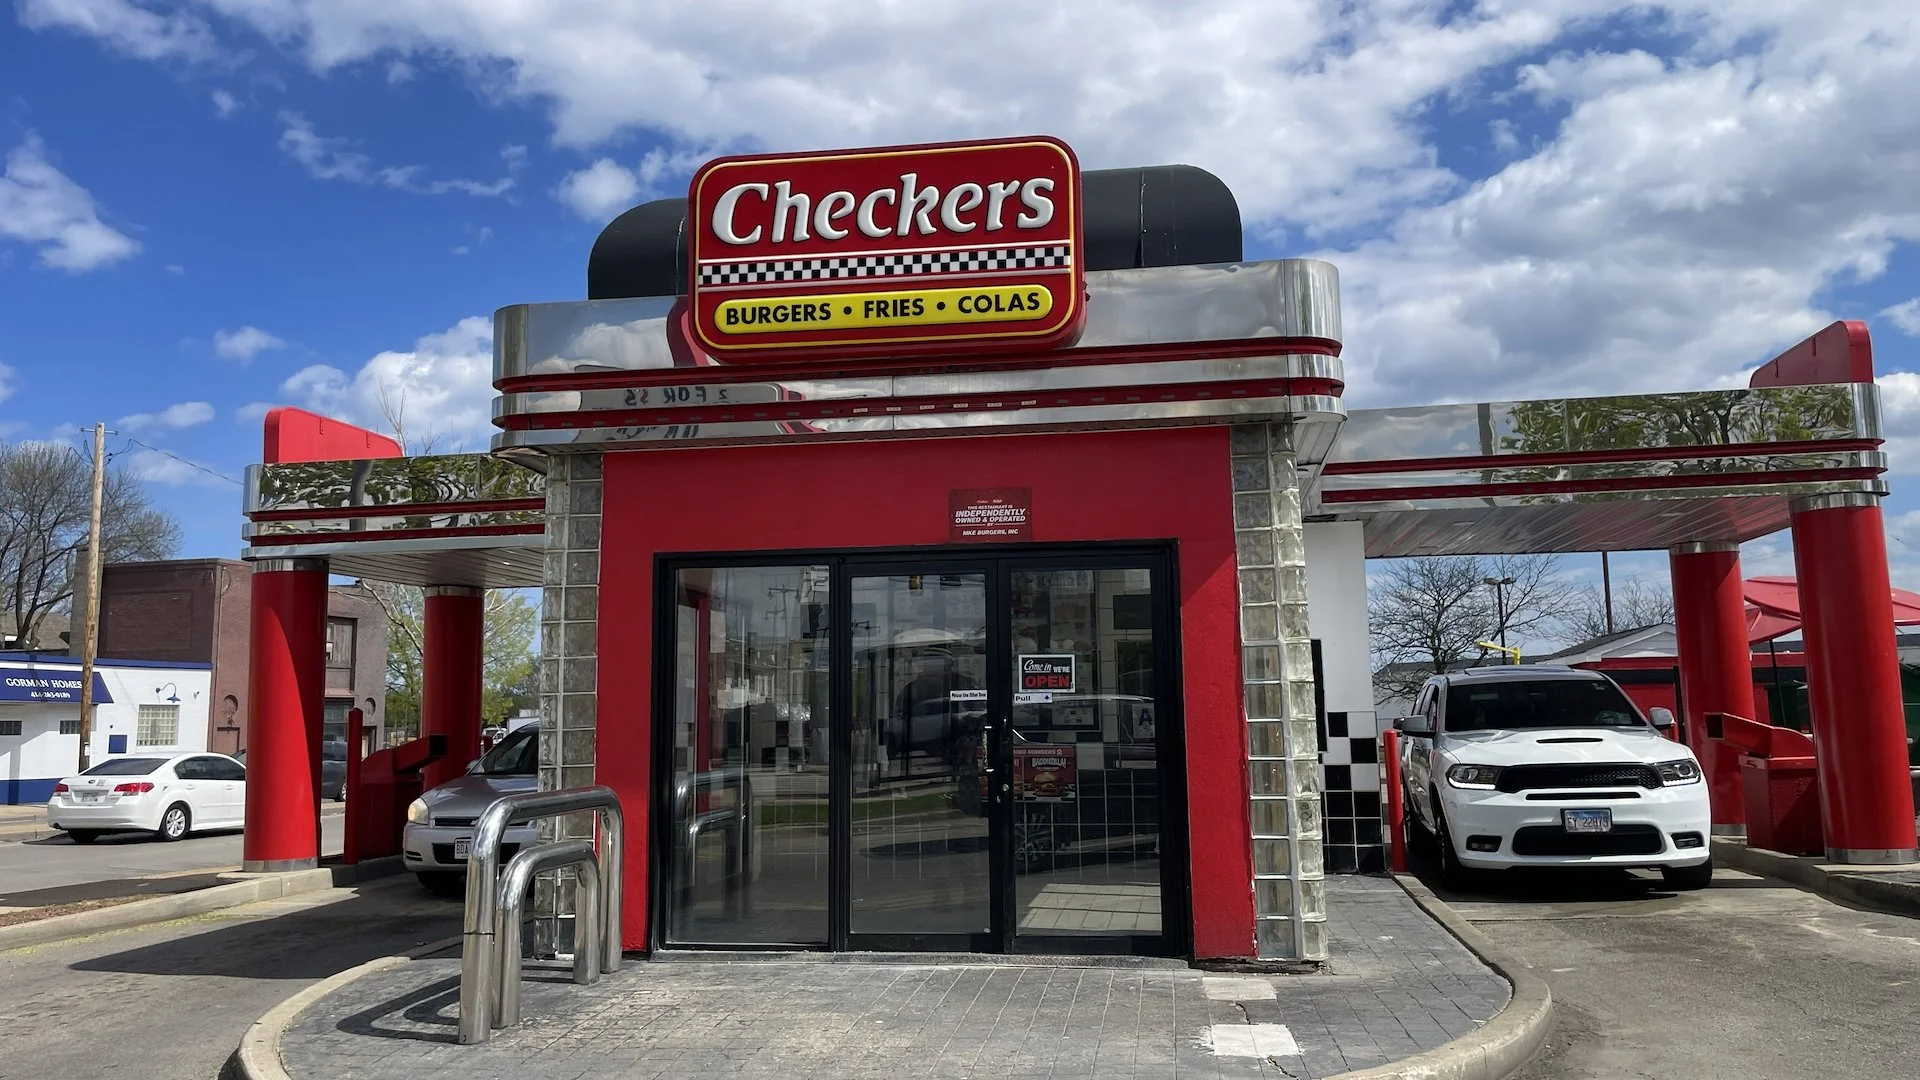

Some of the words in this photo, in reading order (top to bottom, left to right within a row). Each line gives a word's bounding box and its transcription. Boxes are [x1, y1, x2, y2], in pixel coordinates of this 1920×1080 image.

[711, 172, 1056, 245] Checkers
[725, 303, 832, 326] BURGERS
[863, 297, 925, 319] FRIES
[957, 292, 1041, 314] COLAS
[955, 509, 1026, 517] INDEPENDENTLY
[1024, 659, 1044, 671] Come
[1044, 663, 1052, 671] in
[6, 678, 49, 688] GORMAN
[51, 679, 82, 689] HOMES
[1024, 675, 1070, 688] OPEN
